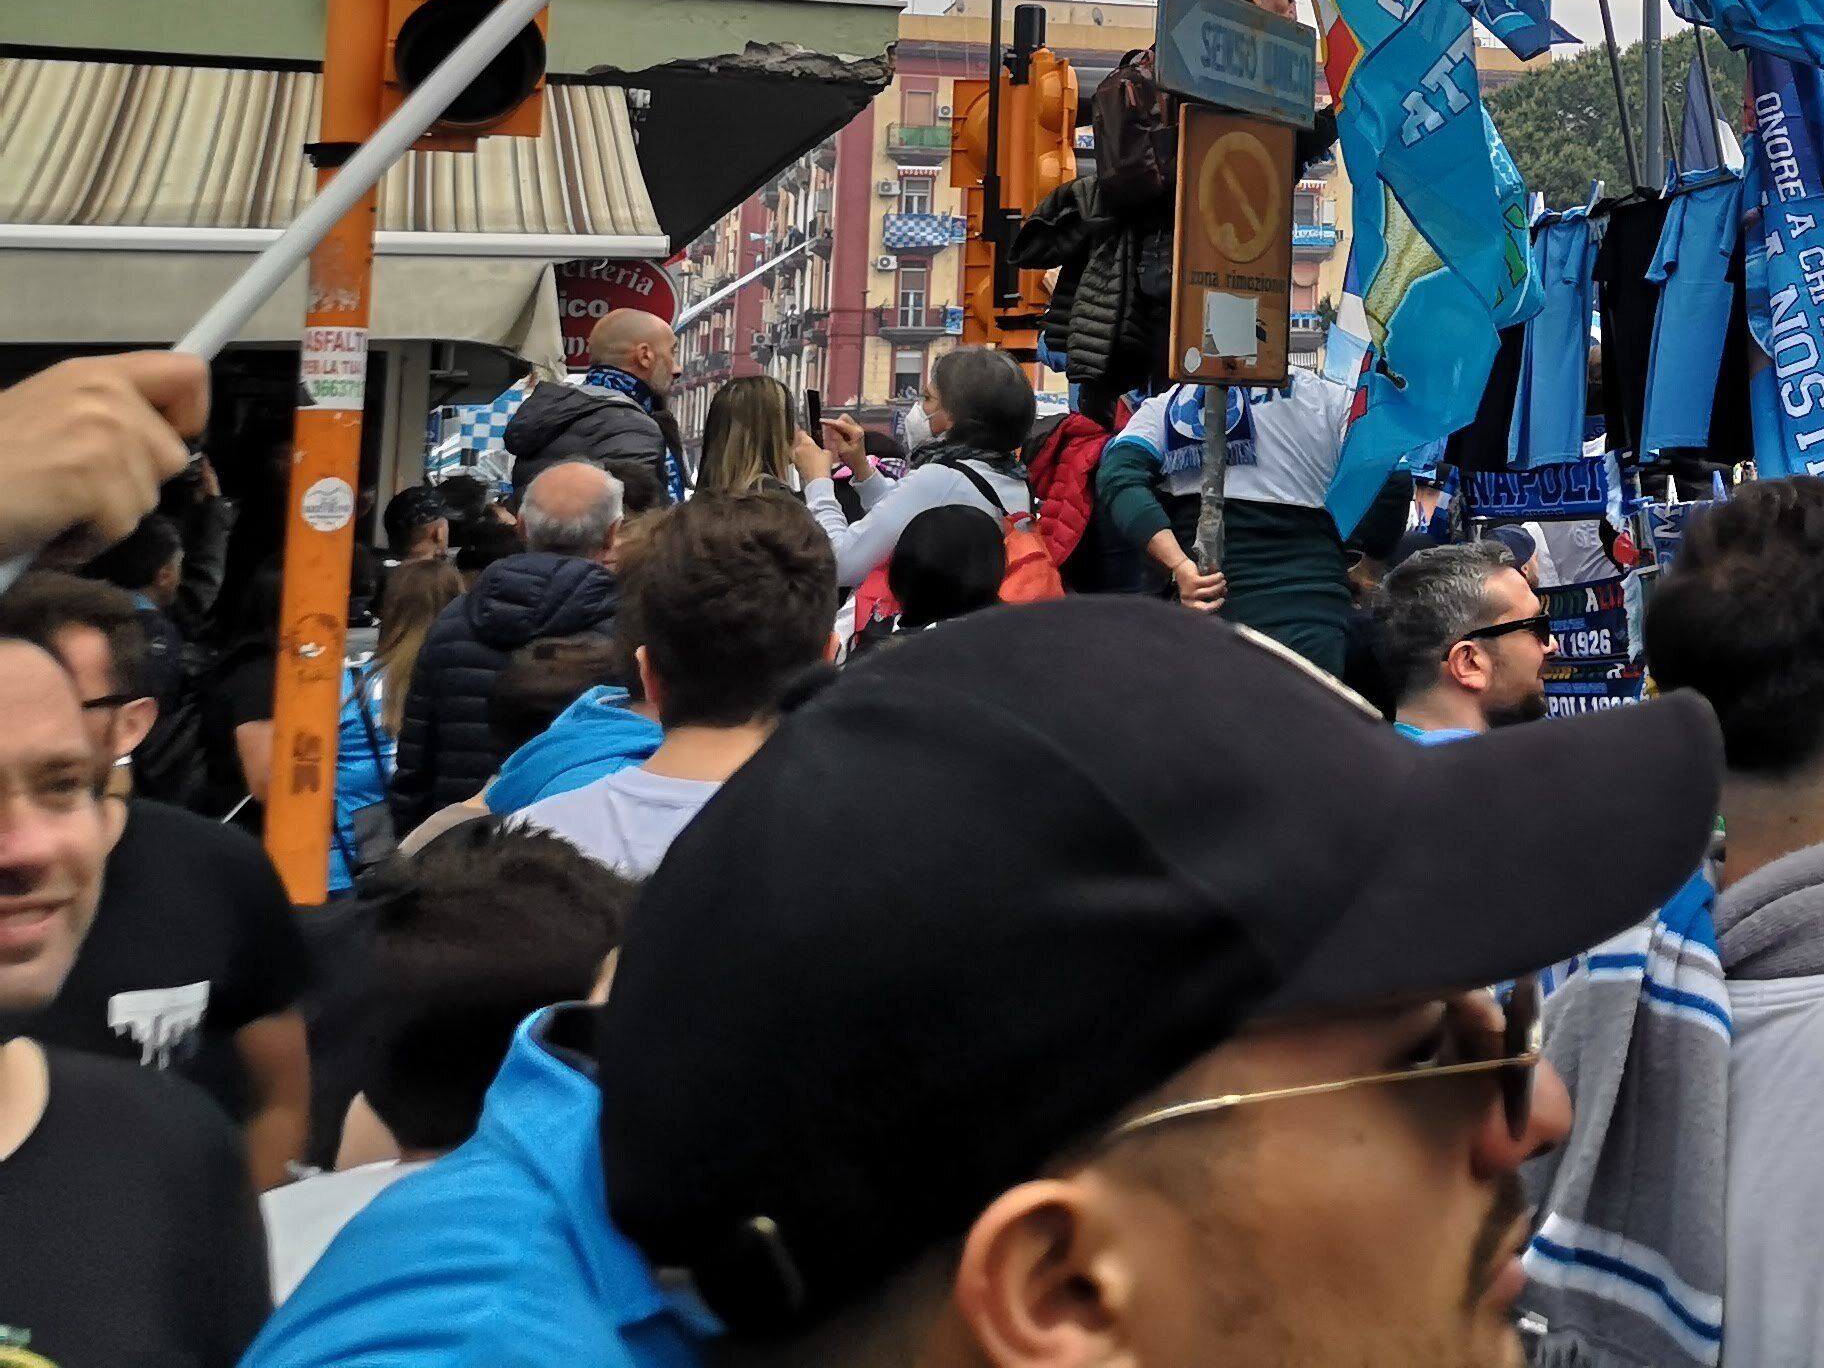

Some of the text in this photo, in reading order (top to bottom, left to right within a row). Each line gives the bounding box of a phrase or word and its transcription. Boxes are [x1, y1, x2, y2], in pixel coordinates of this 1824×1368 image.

[1754, 91, 1807, 205] ONORE
[1785, 212, 1817, 241] A
[1569, 628, 1612, 658] 1926
